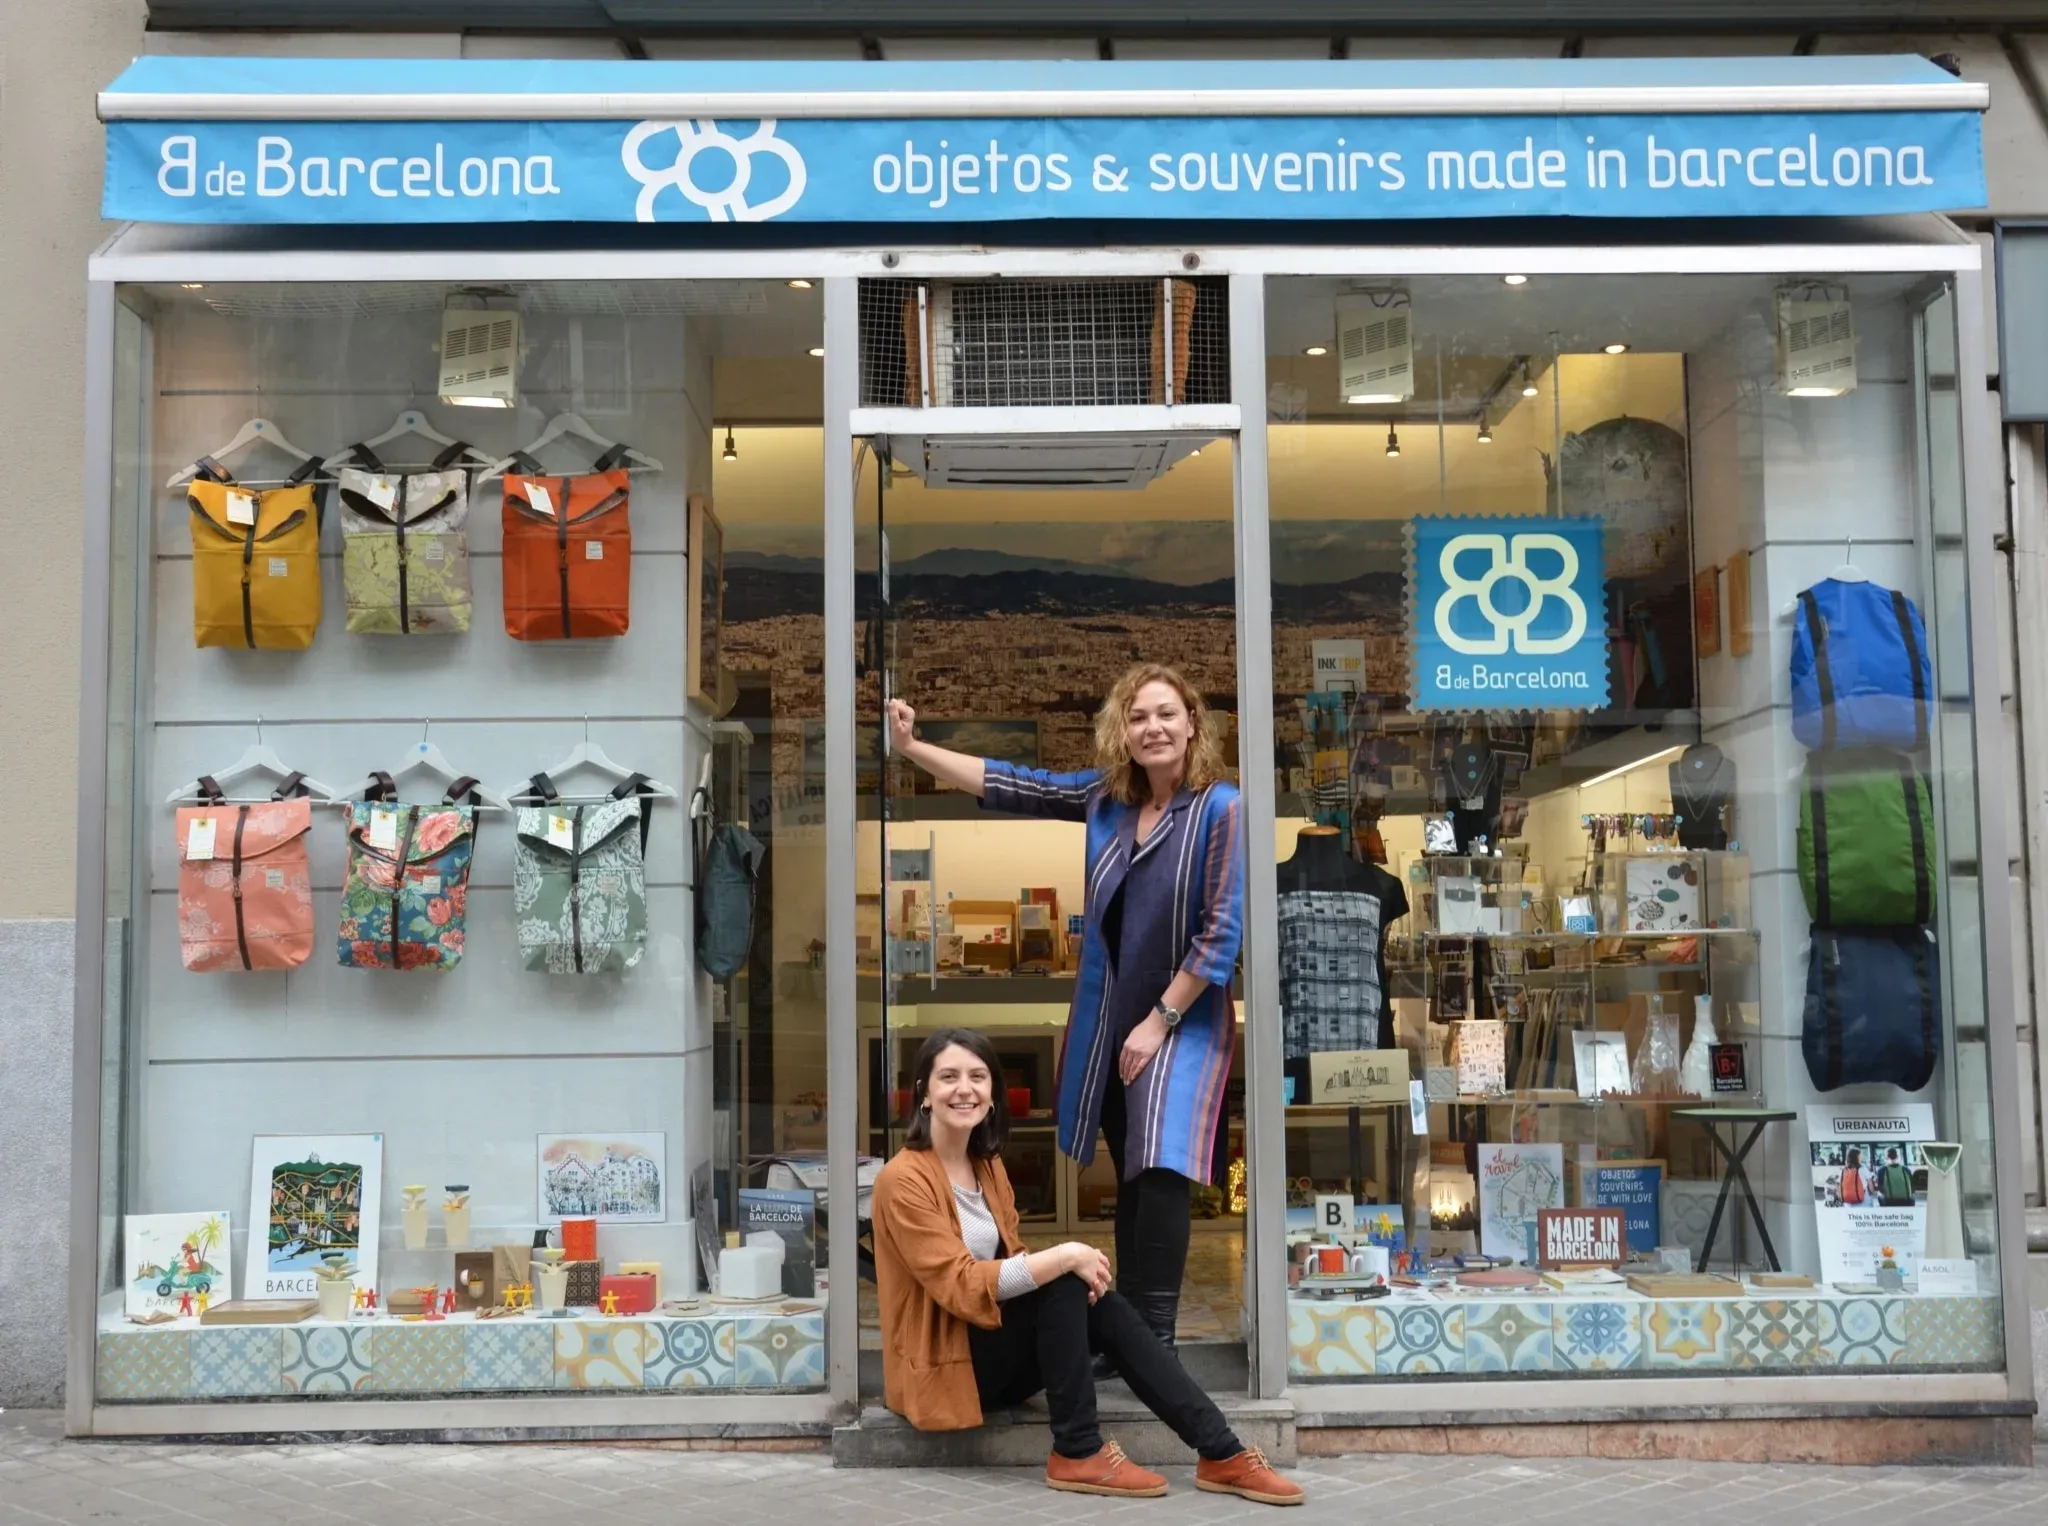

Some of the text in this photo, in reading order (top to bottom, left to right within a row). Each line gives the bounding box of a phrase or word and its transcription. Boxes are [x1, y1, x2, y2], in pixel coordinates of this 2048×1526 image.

[205, 160, 246, 197] de
[256, 135, 561, 198] Barcelona
[873, 133, 1934, 209] objetos & souvenirs made in barcelona
[1318, 656, 1337, 670] INK
[1453, 674, 1470, 690] de
[1473, 663, 1590, 690] Barcelona
[1836, 1120, 1906, 1131] URBANAUTA
[1601, 1169, 1637, 1180] OBJETOS
[1600, 1181, 1644, 1193] SOUVENIRS
[1611, 1193, 1630, 1204] WITH
[1632, 1193, 1653, 1204] LOVE
[750, 1203, 762, 1213] LA
[790, 1204, 803, 1214] DE
[1326, 1202, 1342, 1226] B
[749, 1212, 804, 1223] BARCELONA
[1848, 1213, 1914, 1222] This is the safe bag
[1546, 1216, 1619, 1242] MADE IN
[1855, 1220, 1909, 1228] 100% Barcelona
[1547, 1241, 1620, 1261] BARCELONA
